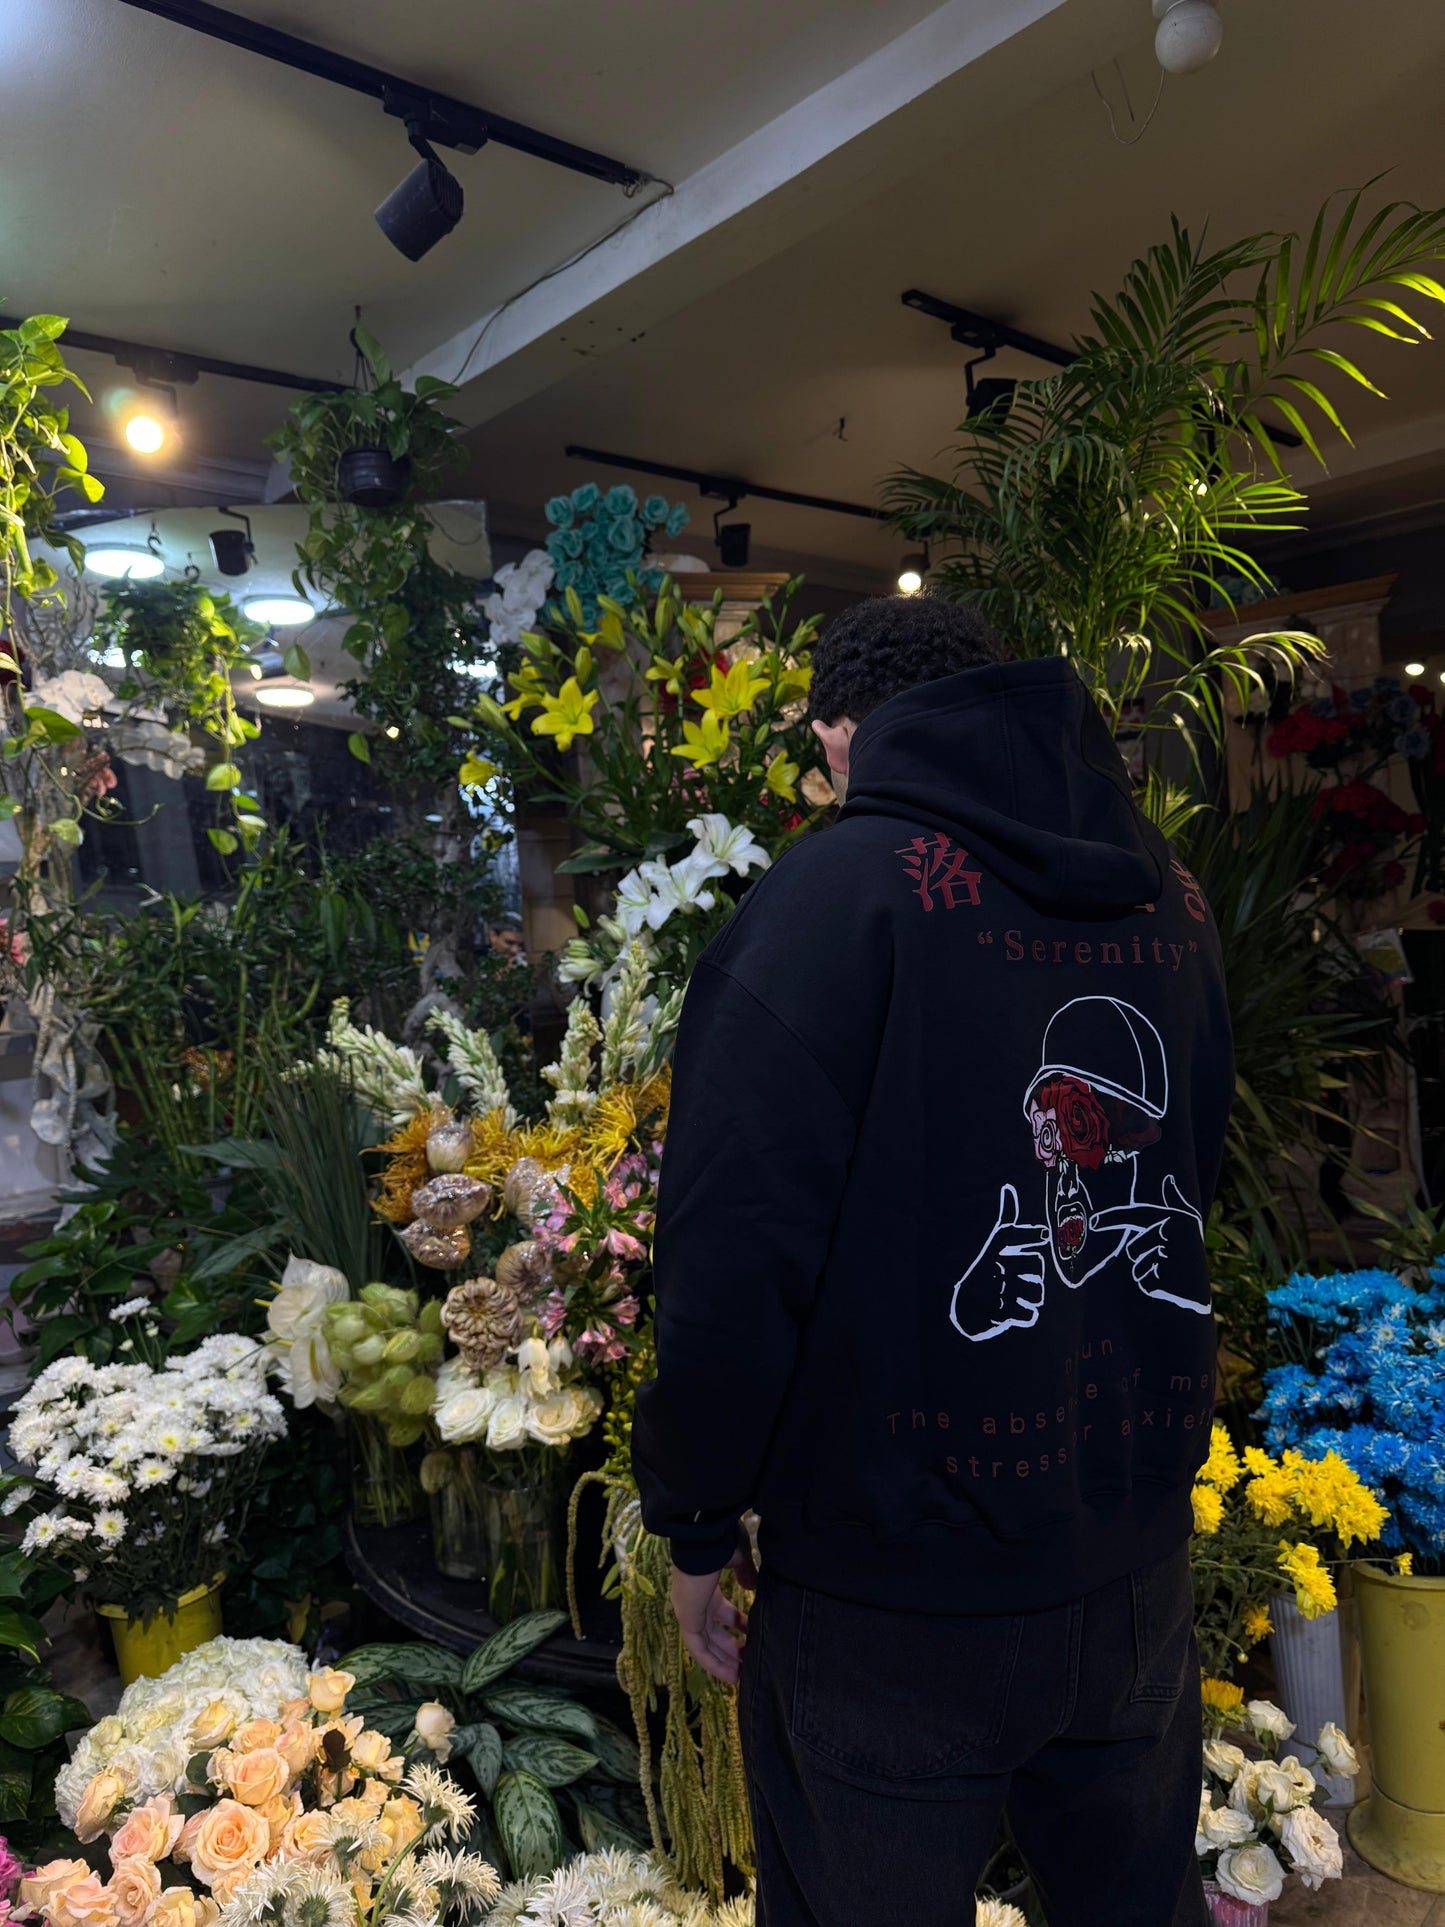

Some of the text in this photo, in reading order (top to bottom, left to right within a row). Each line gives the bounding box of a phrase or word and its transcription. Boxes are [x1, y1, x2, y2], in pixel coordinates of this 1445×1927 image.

[885, 1366, 1212, 1436] The absee of me
[945, 1447, 1068, 1479] stress
